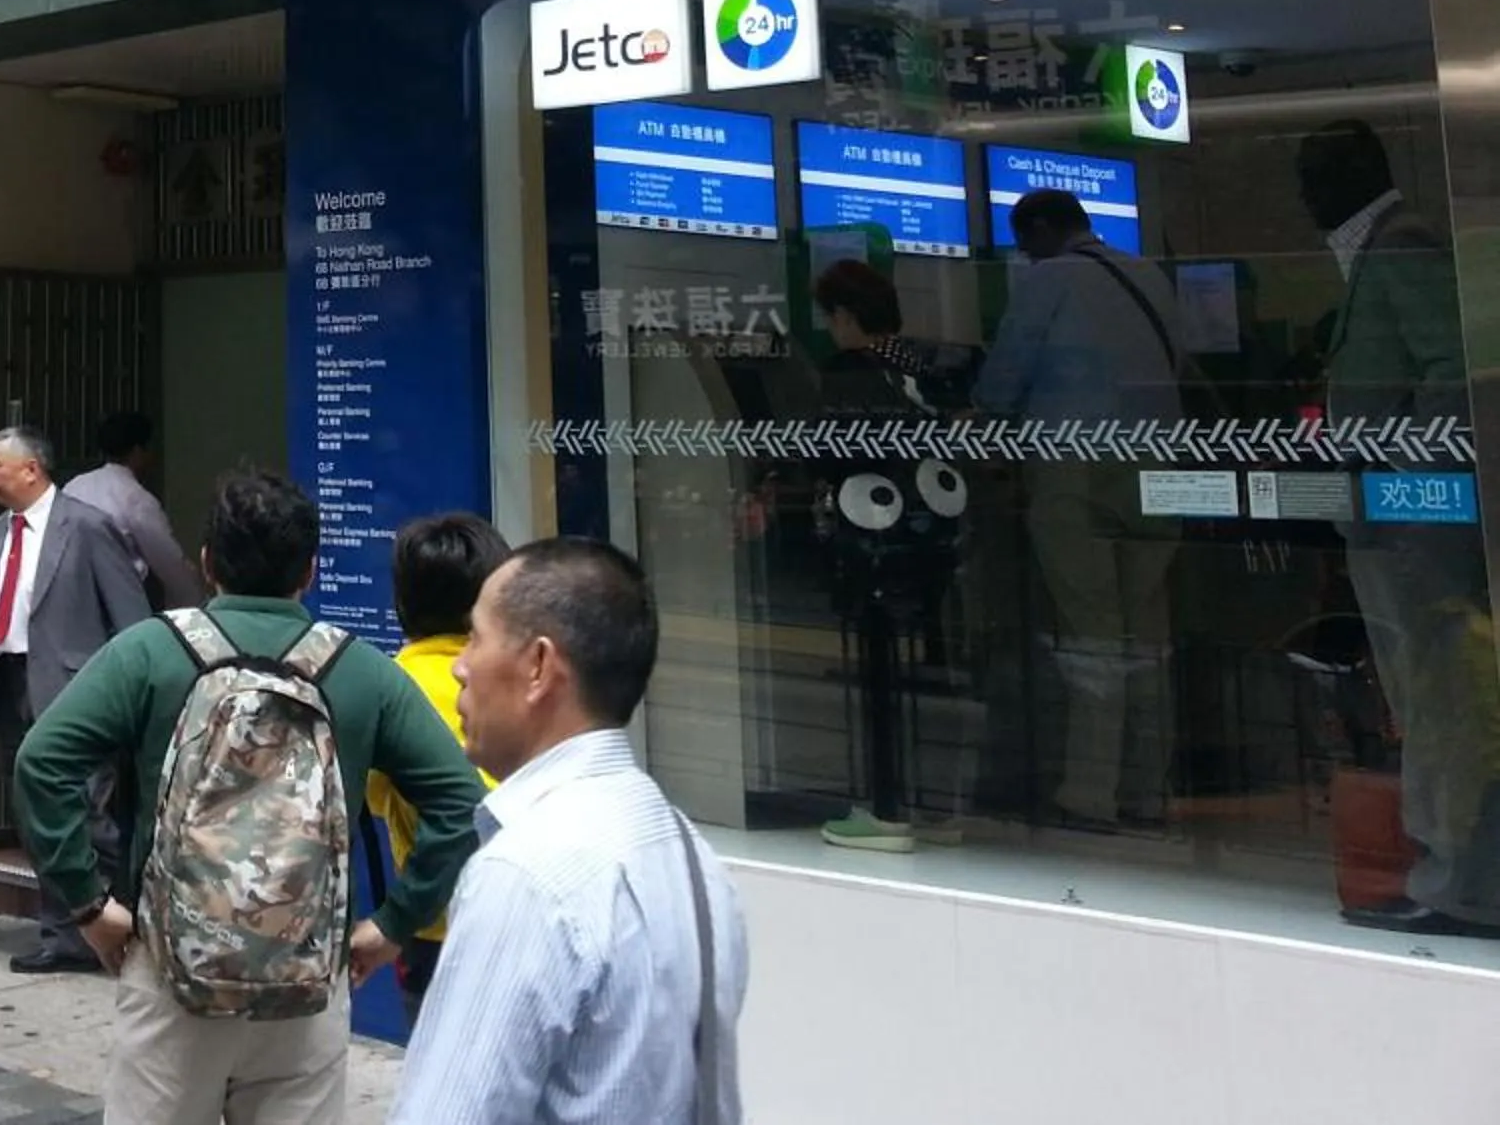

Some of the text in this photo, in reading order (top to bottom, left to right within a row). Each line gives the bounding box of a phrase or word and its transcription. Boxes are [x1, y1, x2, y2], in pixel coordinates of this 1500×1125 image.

[543, 23, 671, 76] Jetco
[638, 120, 665, 137] ATM
[315, 191, 386, 212] Welcome
[329, 245, 356, 260] Hong
[357, 242, 384, 259] Kong
[1380, 477, 1463, 511] 欢迎!
